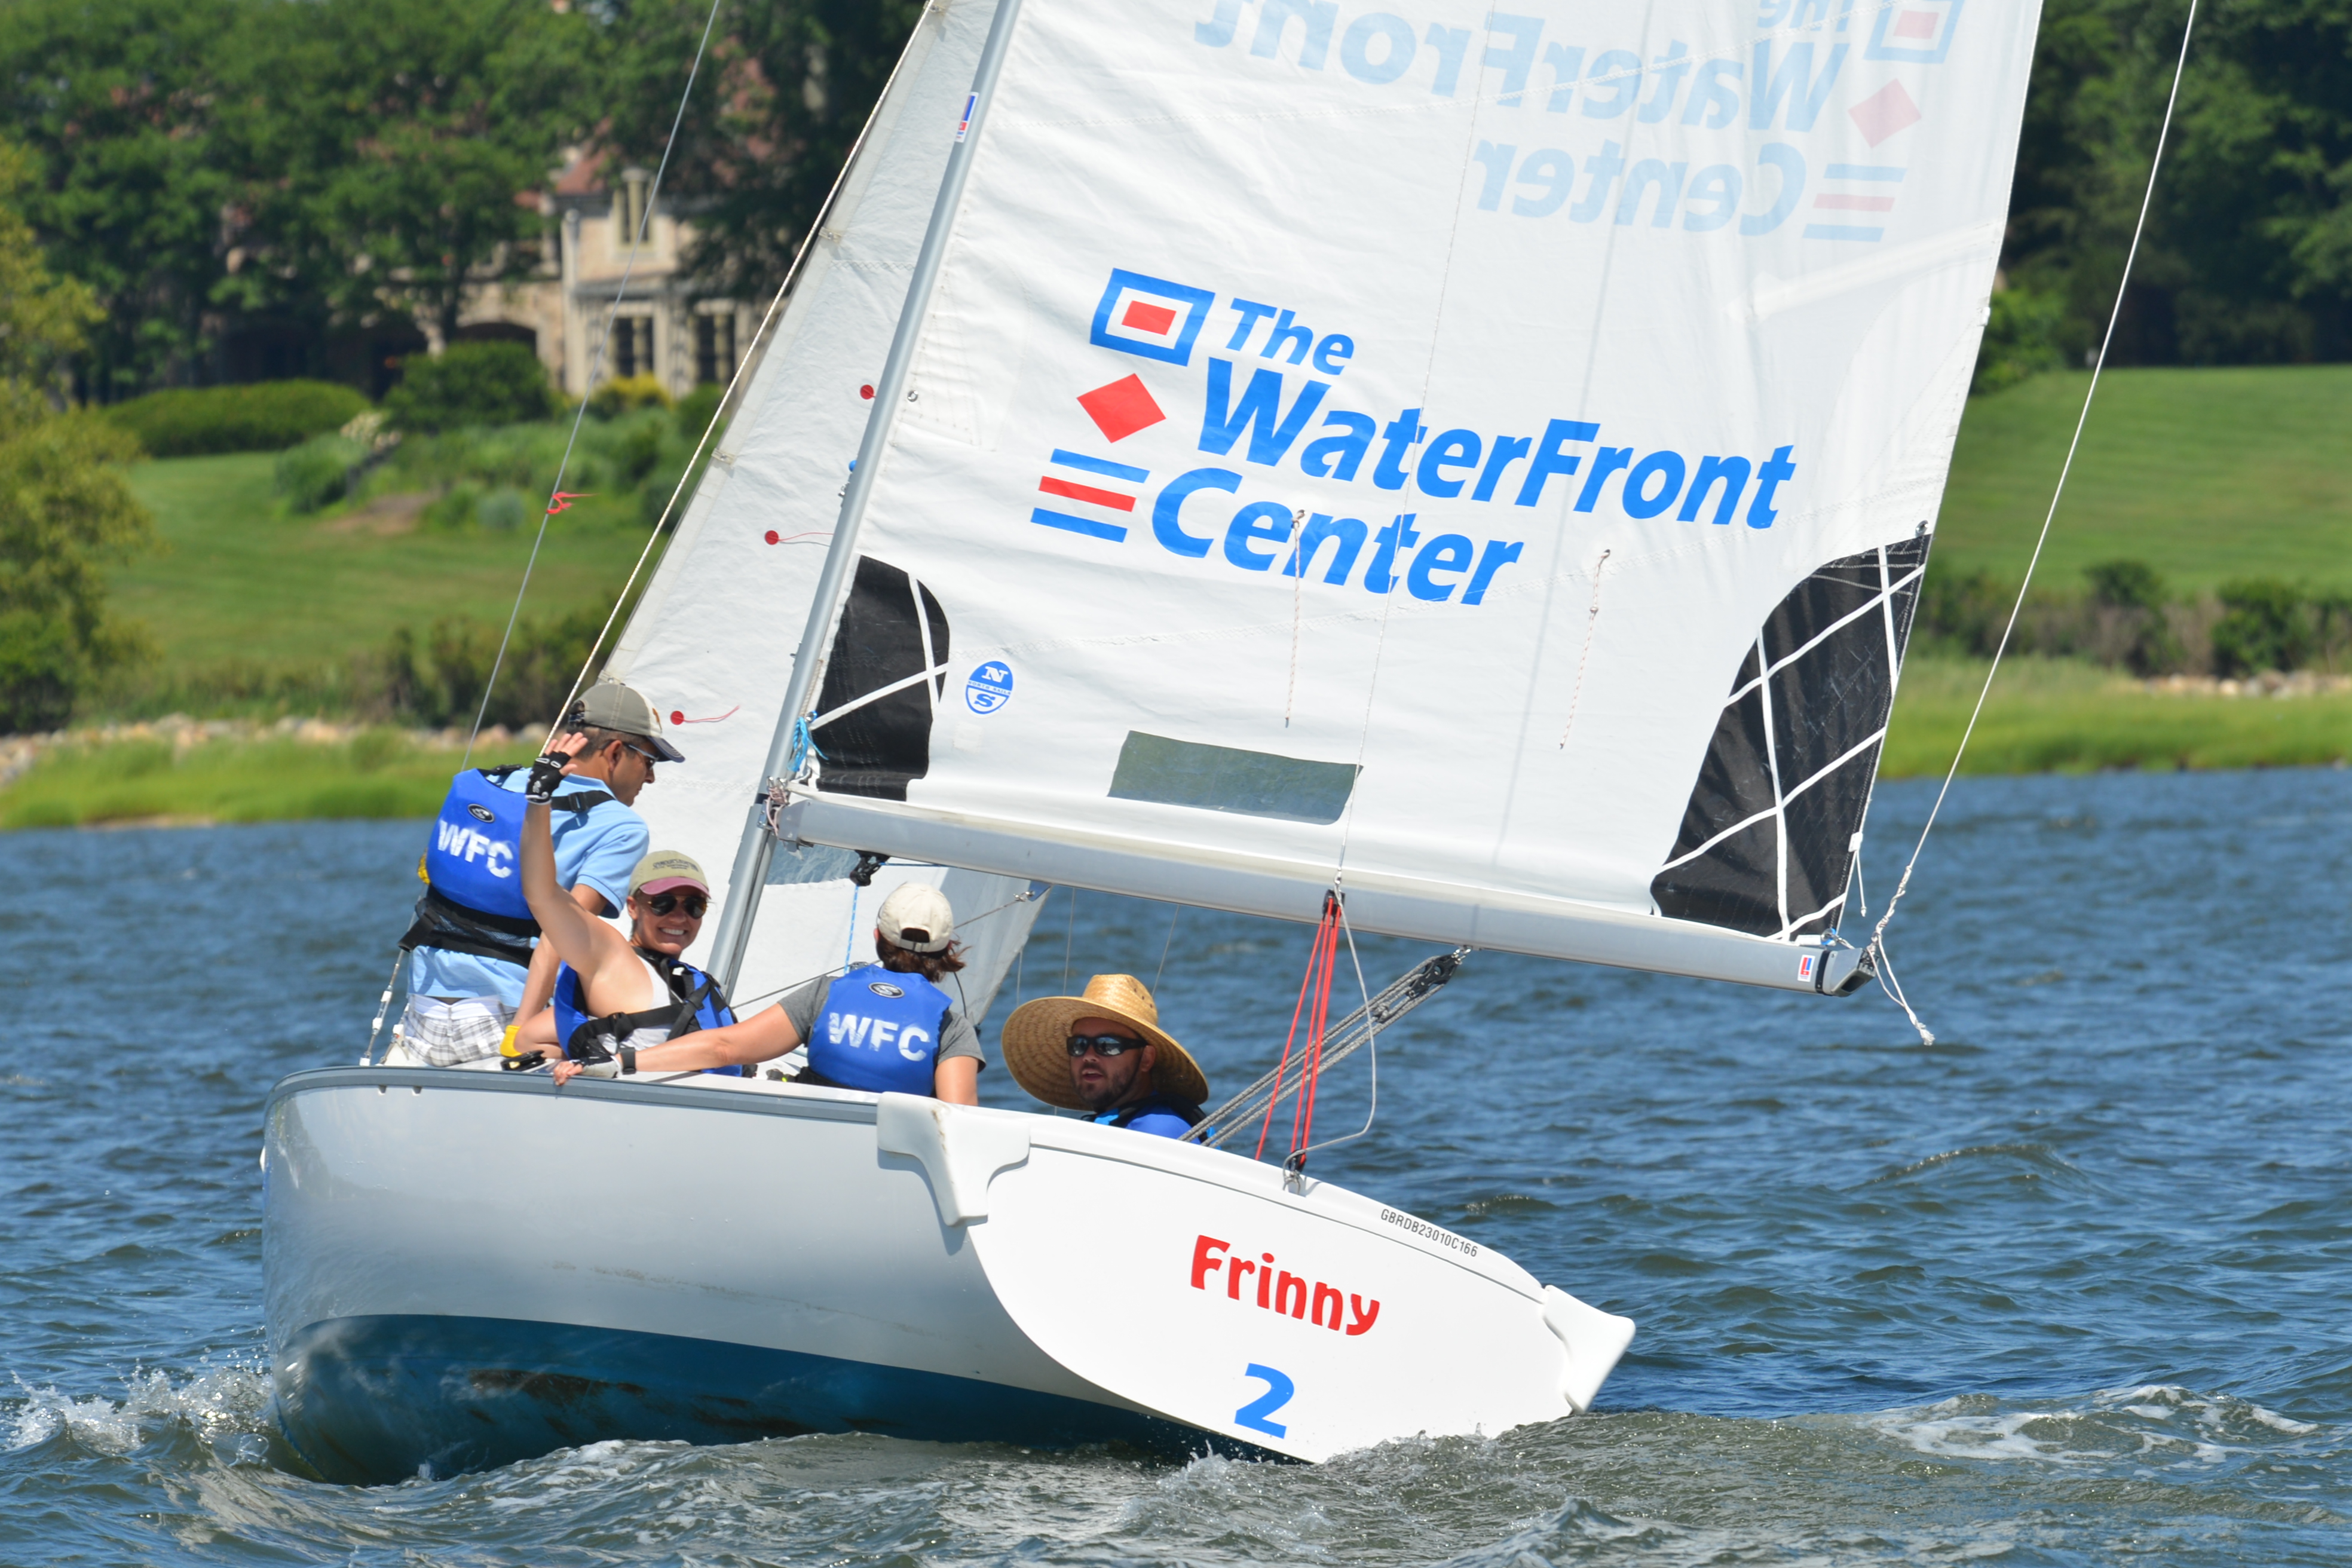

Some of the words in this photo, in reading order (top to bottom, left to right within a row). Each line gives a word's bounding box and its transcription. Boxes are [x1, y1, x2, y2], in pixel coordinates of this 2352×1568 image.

[1226, 298, 1355, 376] The
[1198, 357, 1797, 529] WaterFront
[1152, 467, 1524, 606] Center
[968, 680, 990, 689] NORTH
[974, 693, 996, 708] S
[981, 666, 1008, 682] N
[437, 819, 513, 878] WFC
[829, 1012, 930, 1061] WFC
[1380, 1208, 1478, 1257] GBRDB23010C166
[1191, 1235, 1380, 1336] Frinny
[1234, 1363, 1295, 1439] 2
